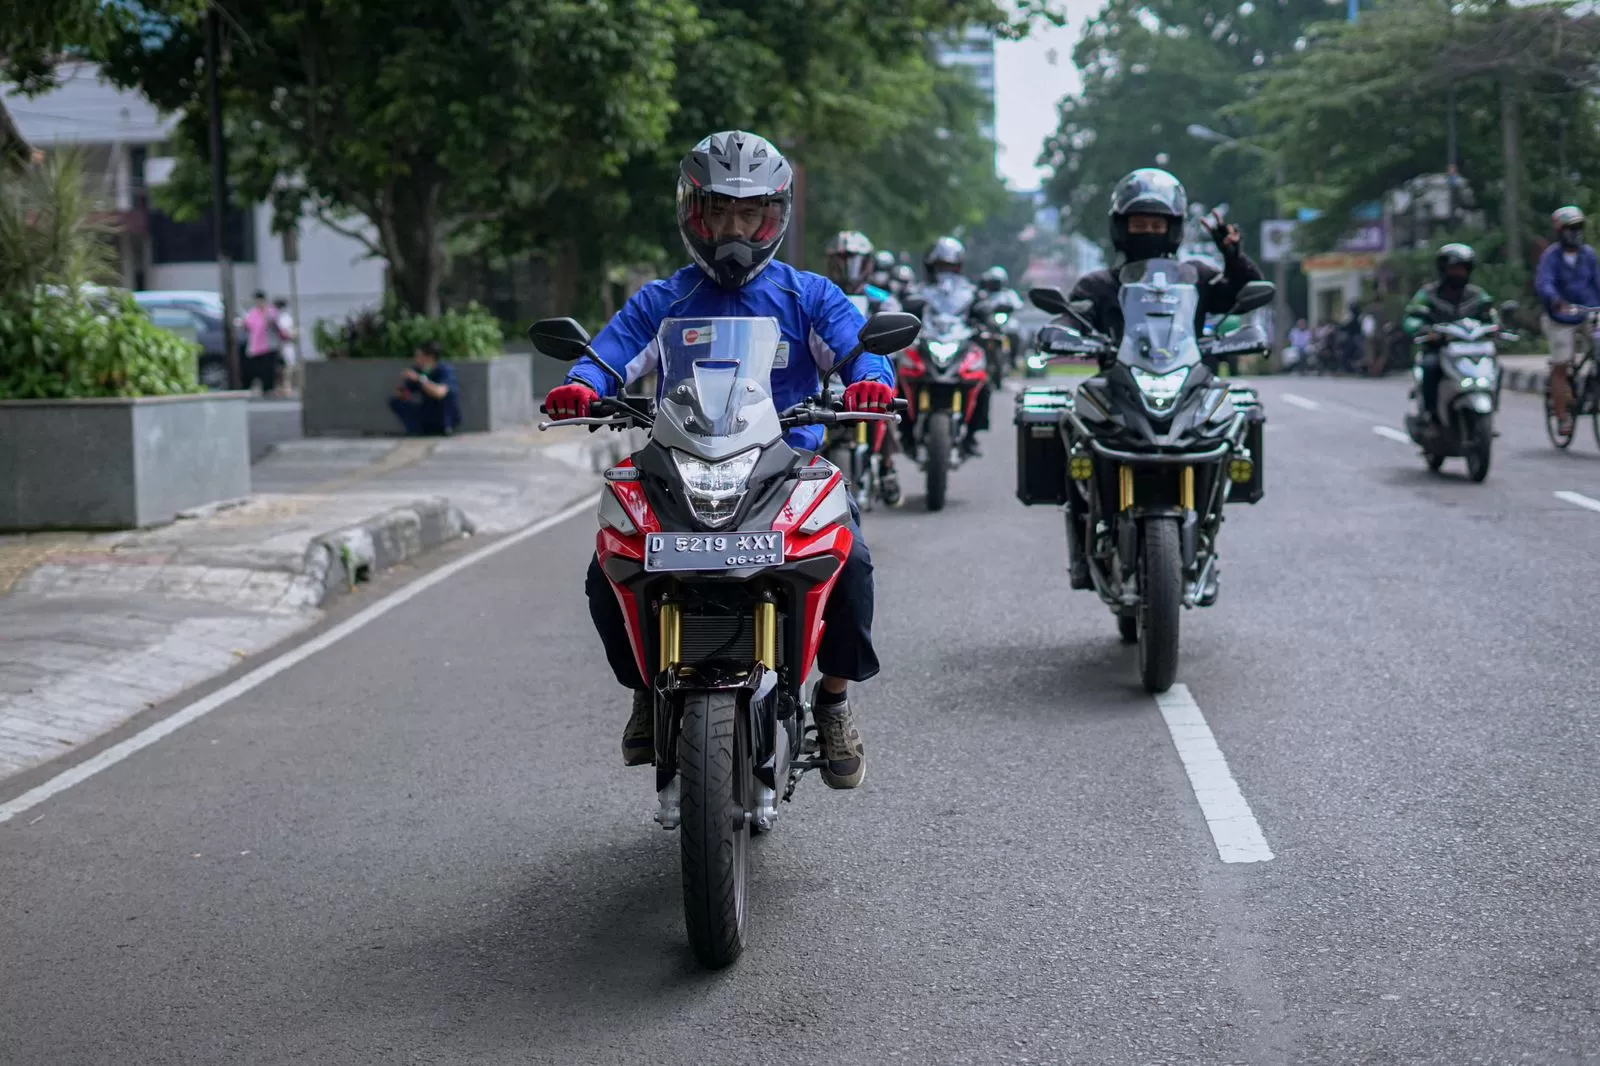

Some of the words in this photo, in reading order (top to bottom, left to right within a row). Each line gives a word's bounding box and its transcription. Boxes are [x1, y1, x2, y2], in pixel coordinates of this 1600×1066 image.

[651, 536, 664, 552] D
[675, 536, 727, 552] 5219
[736, 534, 777, 550] XXY
[726, 553, 777, 565] 06-27
